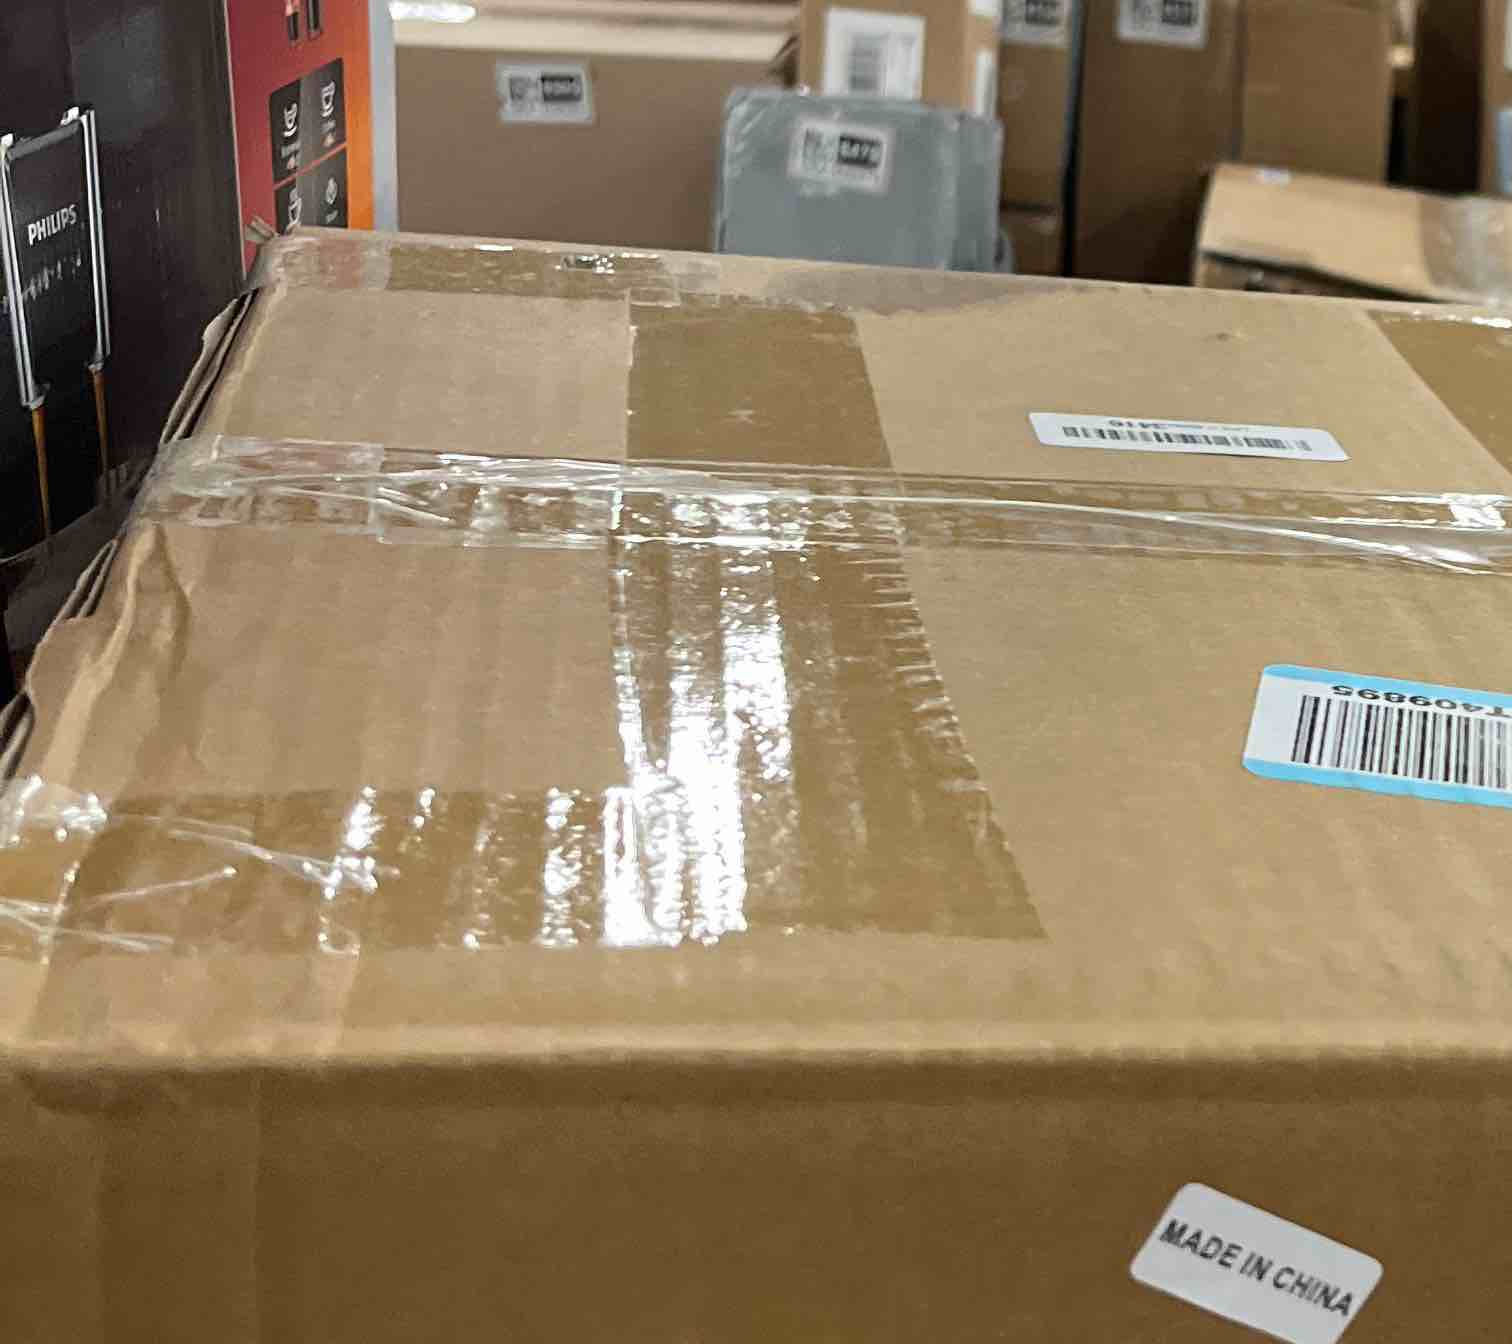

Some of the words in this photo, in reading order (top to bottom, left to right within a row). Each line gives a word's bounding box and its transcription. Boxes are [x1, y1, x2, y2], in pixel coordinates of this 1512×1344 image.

[27, 204, 77, 246] PHILIPS
[1159, 1217, 1243, 1269] MADE
[1239, 1251, 1274, 1283] IN
[1272, 1266, 1355, 1318] CHINA
